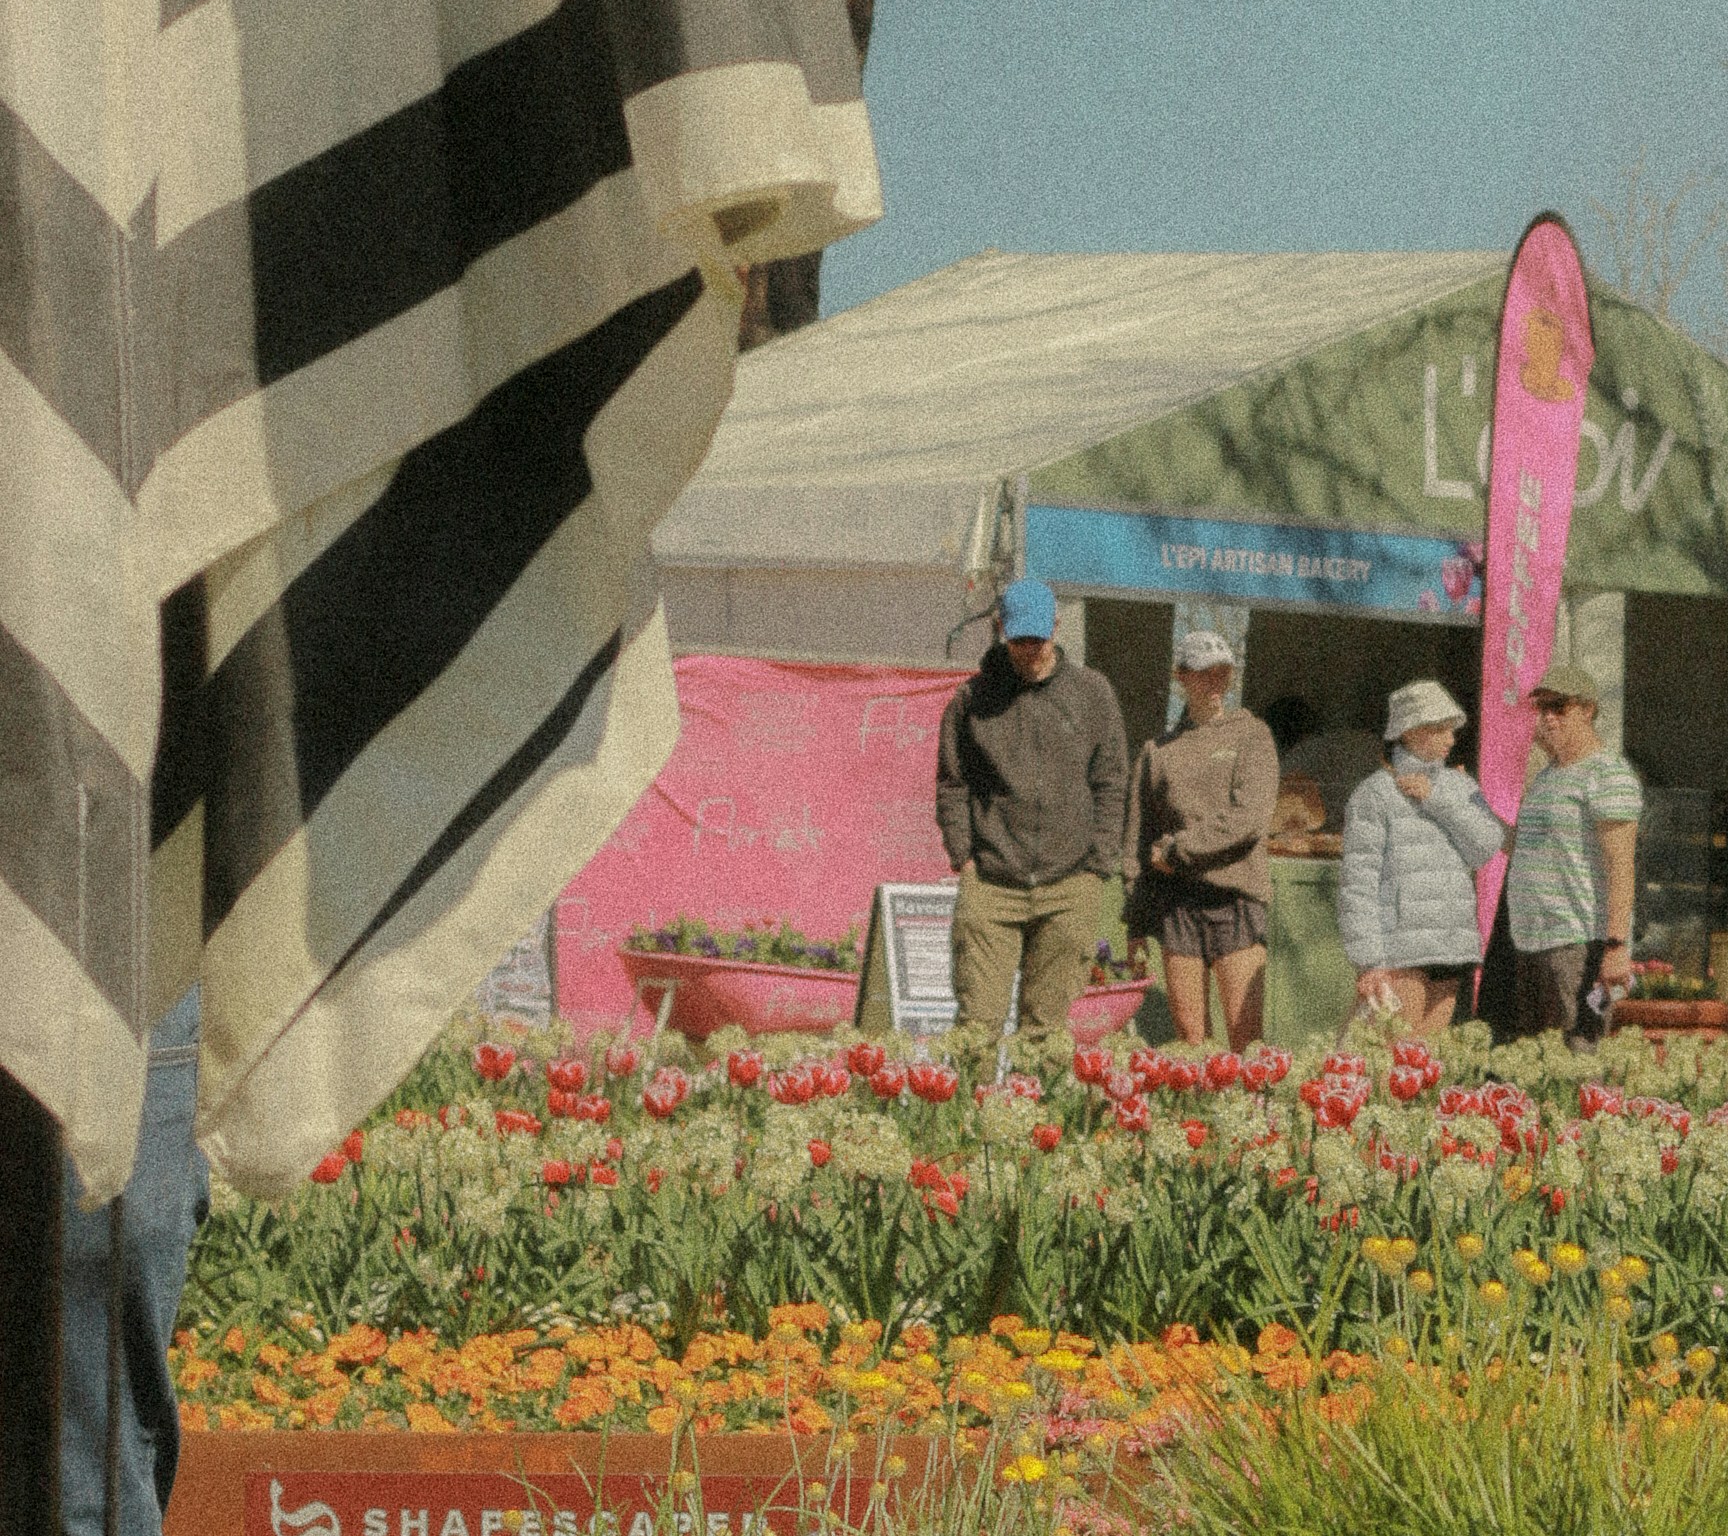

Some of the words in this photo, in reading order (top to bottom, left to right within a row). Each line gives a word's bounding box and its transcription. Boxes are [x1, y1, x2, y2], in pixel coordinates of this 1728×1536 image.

[1210, 548, 1293, 576] ARTISAN
[1296, 554, 1372, 583] BAKERY
[1503, 468, 1543, 707] COFFEE
